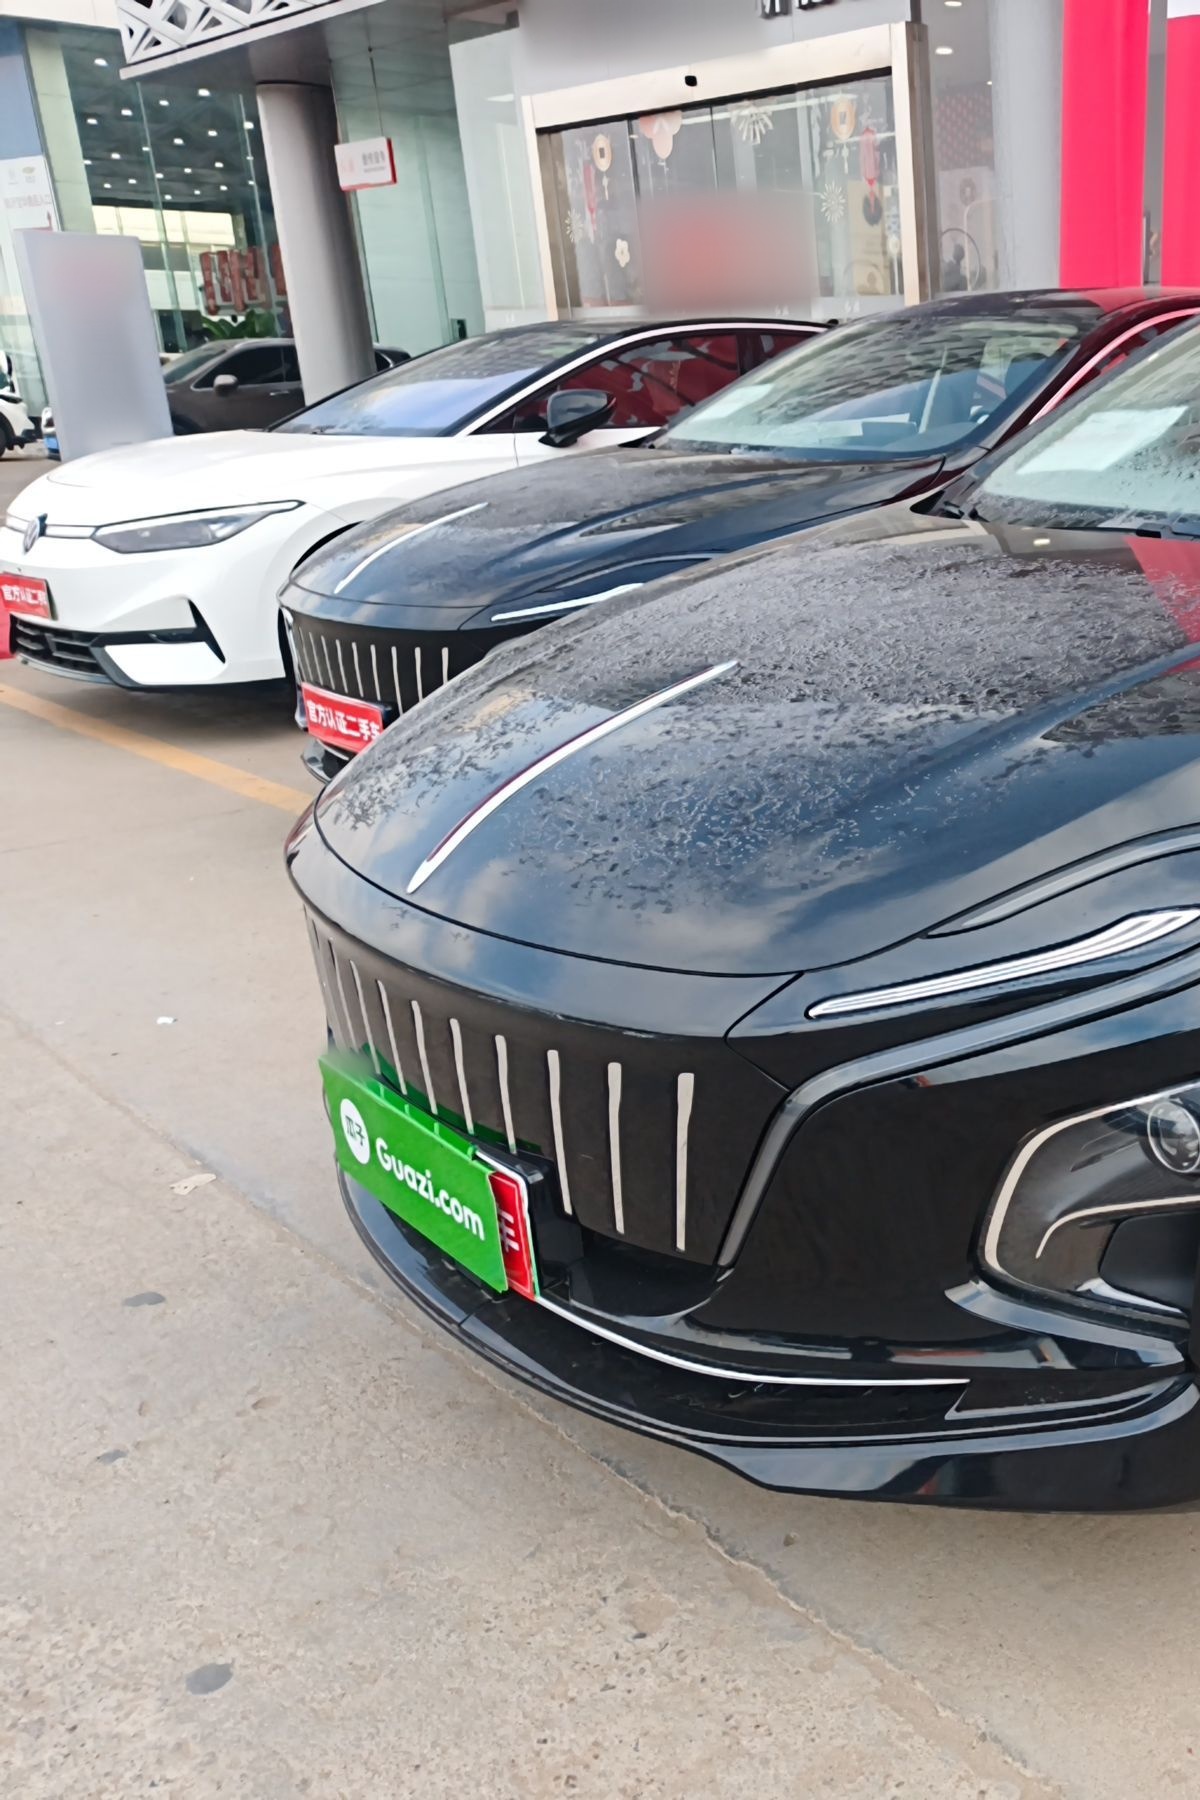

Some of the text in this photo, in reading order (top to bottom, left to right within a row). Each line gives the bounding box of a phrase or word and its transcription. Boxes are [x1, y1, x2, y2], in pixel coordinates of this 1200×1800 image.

[306, 700, 380, 741] 官方认证二手车
